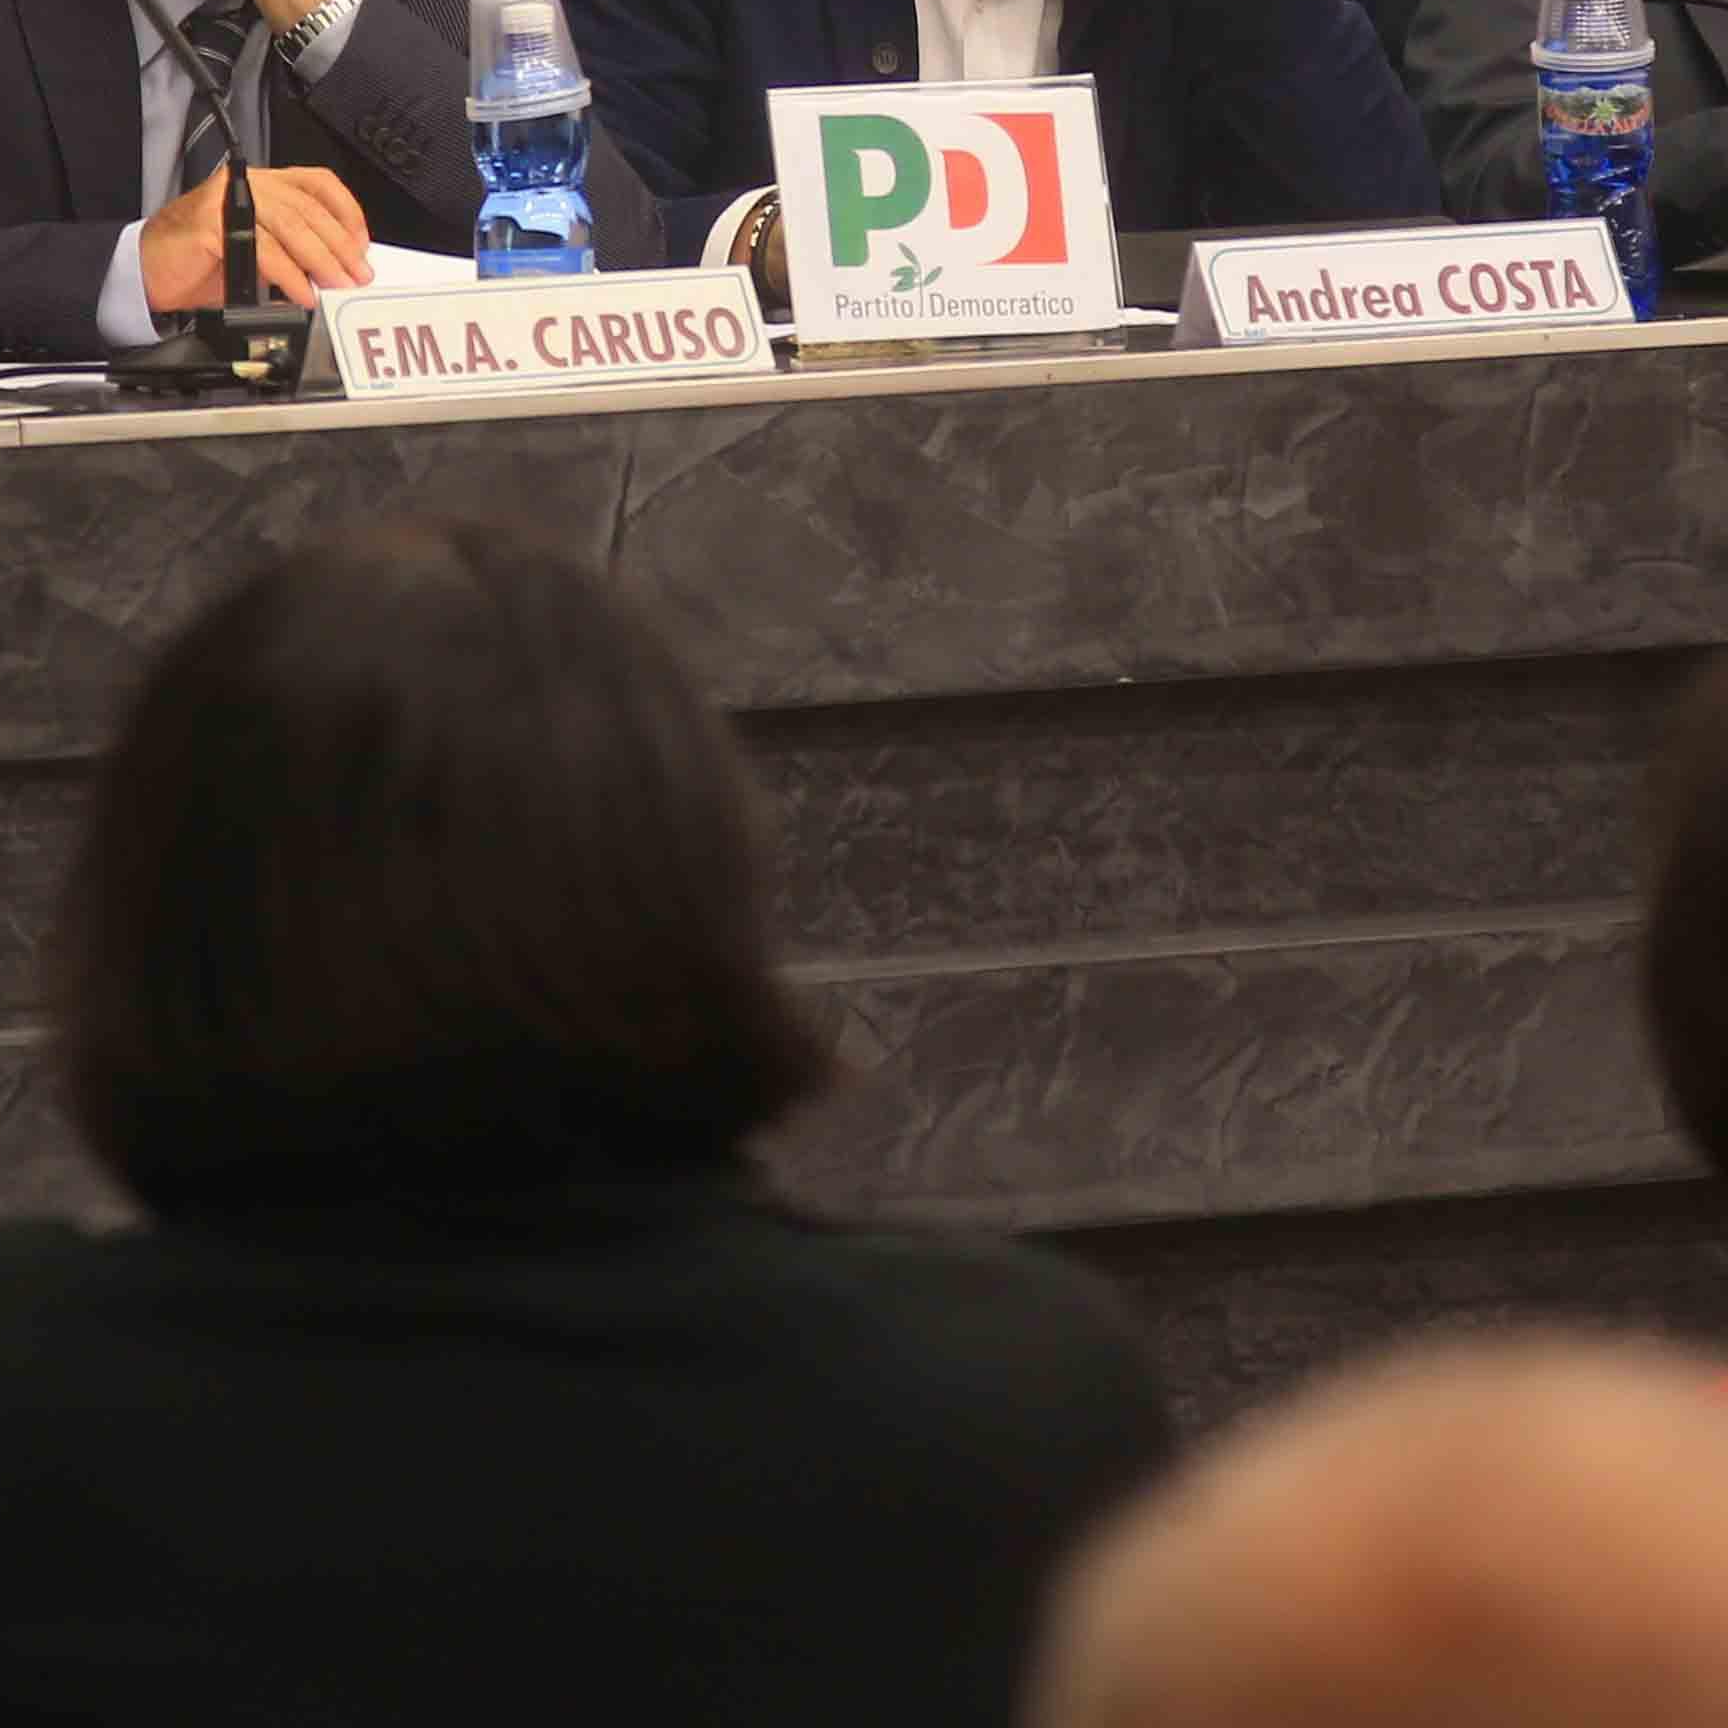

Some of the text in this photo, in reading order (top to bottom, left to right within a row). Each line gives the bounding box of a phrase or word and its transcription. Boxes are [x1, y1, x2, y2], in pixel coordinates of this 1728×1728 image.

[819, 112, 1069, 267] PD
[834, 290, 1074, 319] Partito Democratico
[1246, 258, 1597, 323] Andrea COSTA
[357, 307, 746, 379] F.M.A. CARUSO
